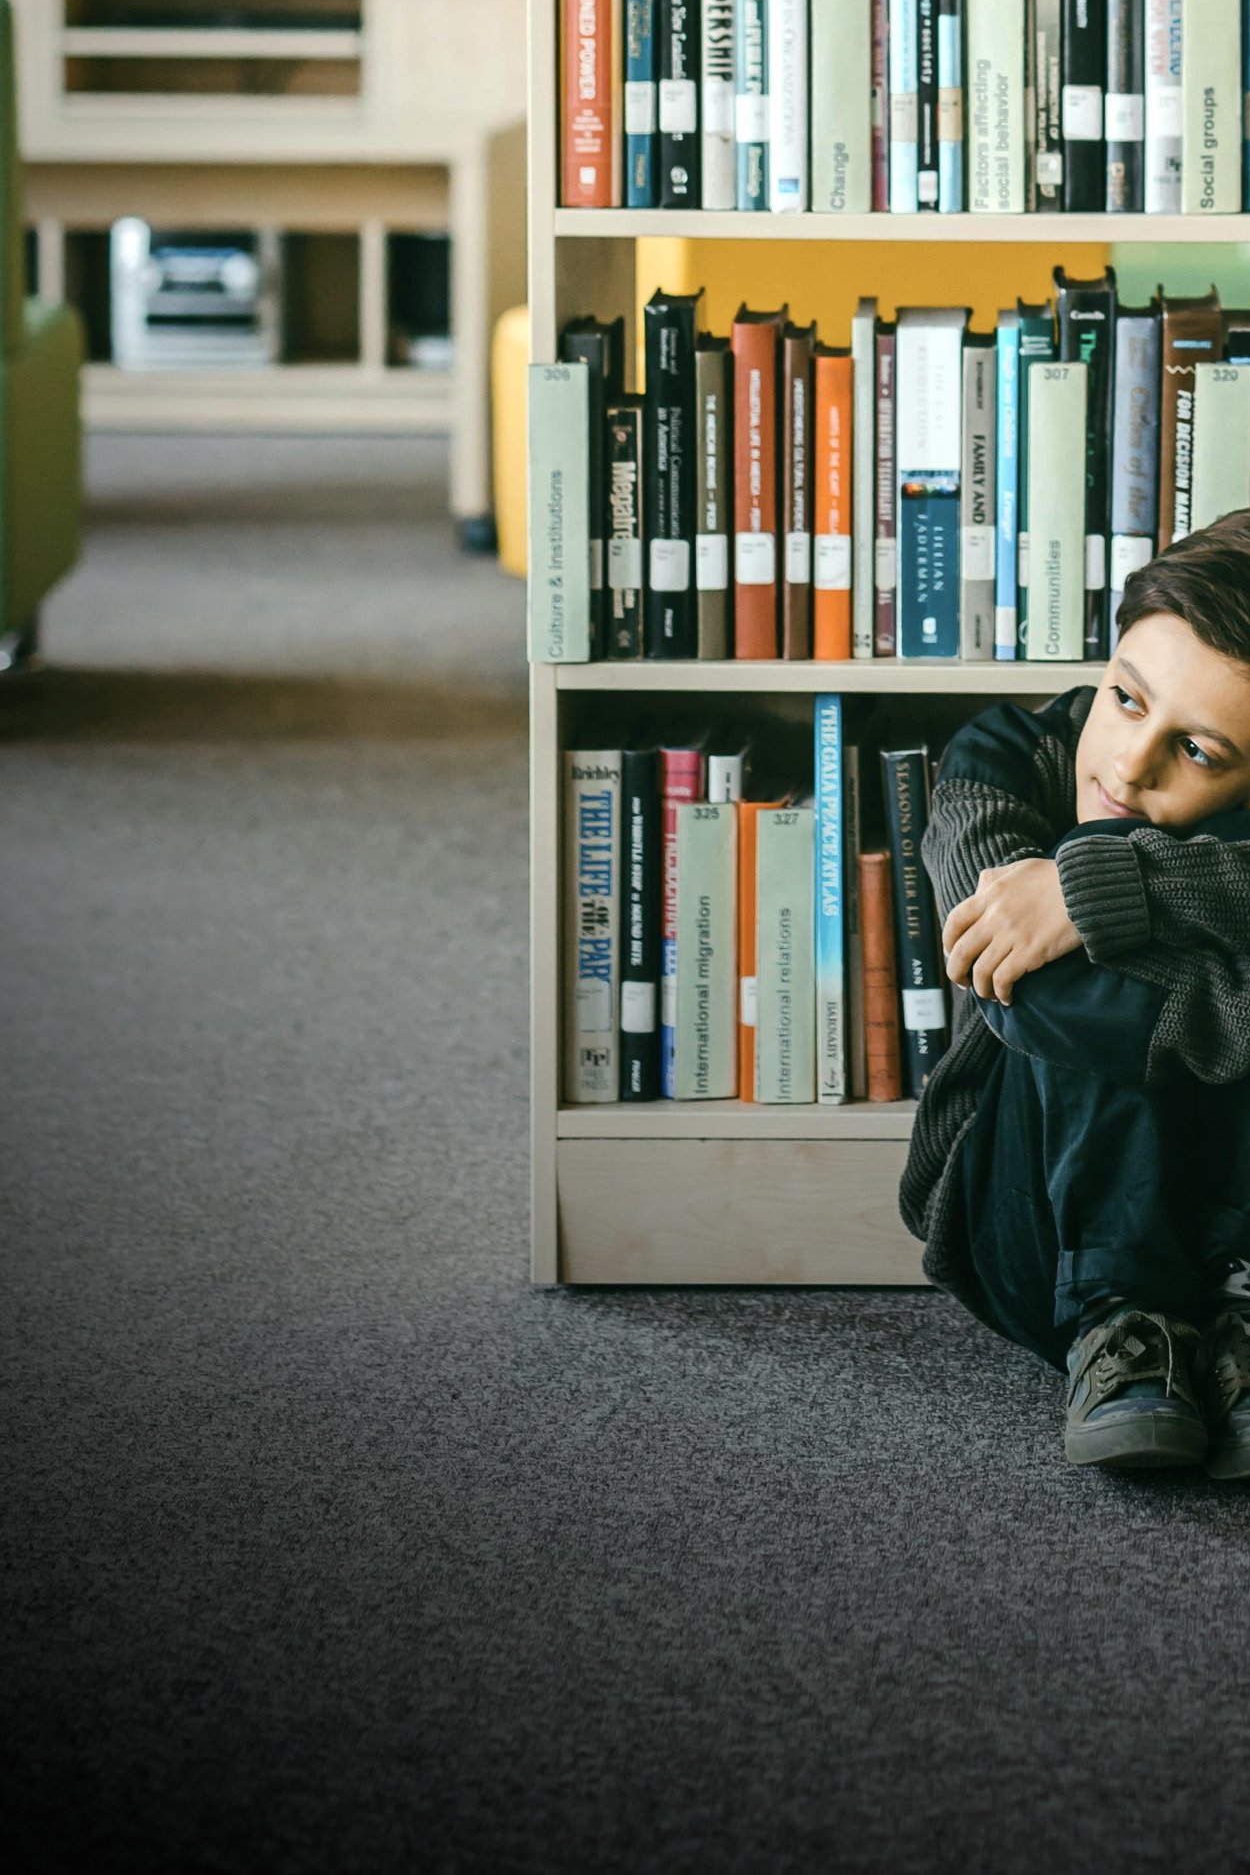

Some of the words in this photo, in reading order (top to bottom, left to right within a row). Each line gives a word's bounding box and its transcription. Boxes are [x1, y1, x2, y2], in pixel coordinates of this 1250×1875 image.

[579, 38, 597, 100] POWER
[974, 59, 992, 138] affecting
[995, 74, 1010, 151] behavior
[1200, 86, 1217, 150] groups
[830, 141, 849, 210] Change
[975, 143, 989, 209] Factors
[997, 158, 1010, 209] social
[1201, 156, 1216, 209] Social
[1177, 390, 1191, 420] FOR
[972, 434, 986, 488] FAMILY
[1174, 423, 1191, 489] DECISION
[548, 470, 564, 569] institutions
[973, 491, 987, 524] AND
[548, 576, 563, 589] &
[1045, 540, 1062, 655] Communities
[549, 593, 564, 659] Culture
[821, 706, 838, 744] THE
[821, 747, 837, 794] GAIA
[894, 762, 912, 833] SEASONS
[579, 791, 612, 839] THE
[821, 796, 838, 855] PEACE
[579, 843, 612, 897] LIFE
[821, 858, 838, 916] ATLAS
[697, 896, 712, 979] migration
[776, 908, 791, 984] relations
[910, 958, 923, 985] ANN
[694, 984, 712, 1094] International
[775, 990, 792, 1100] International
